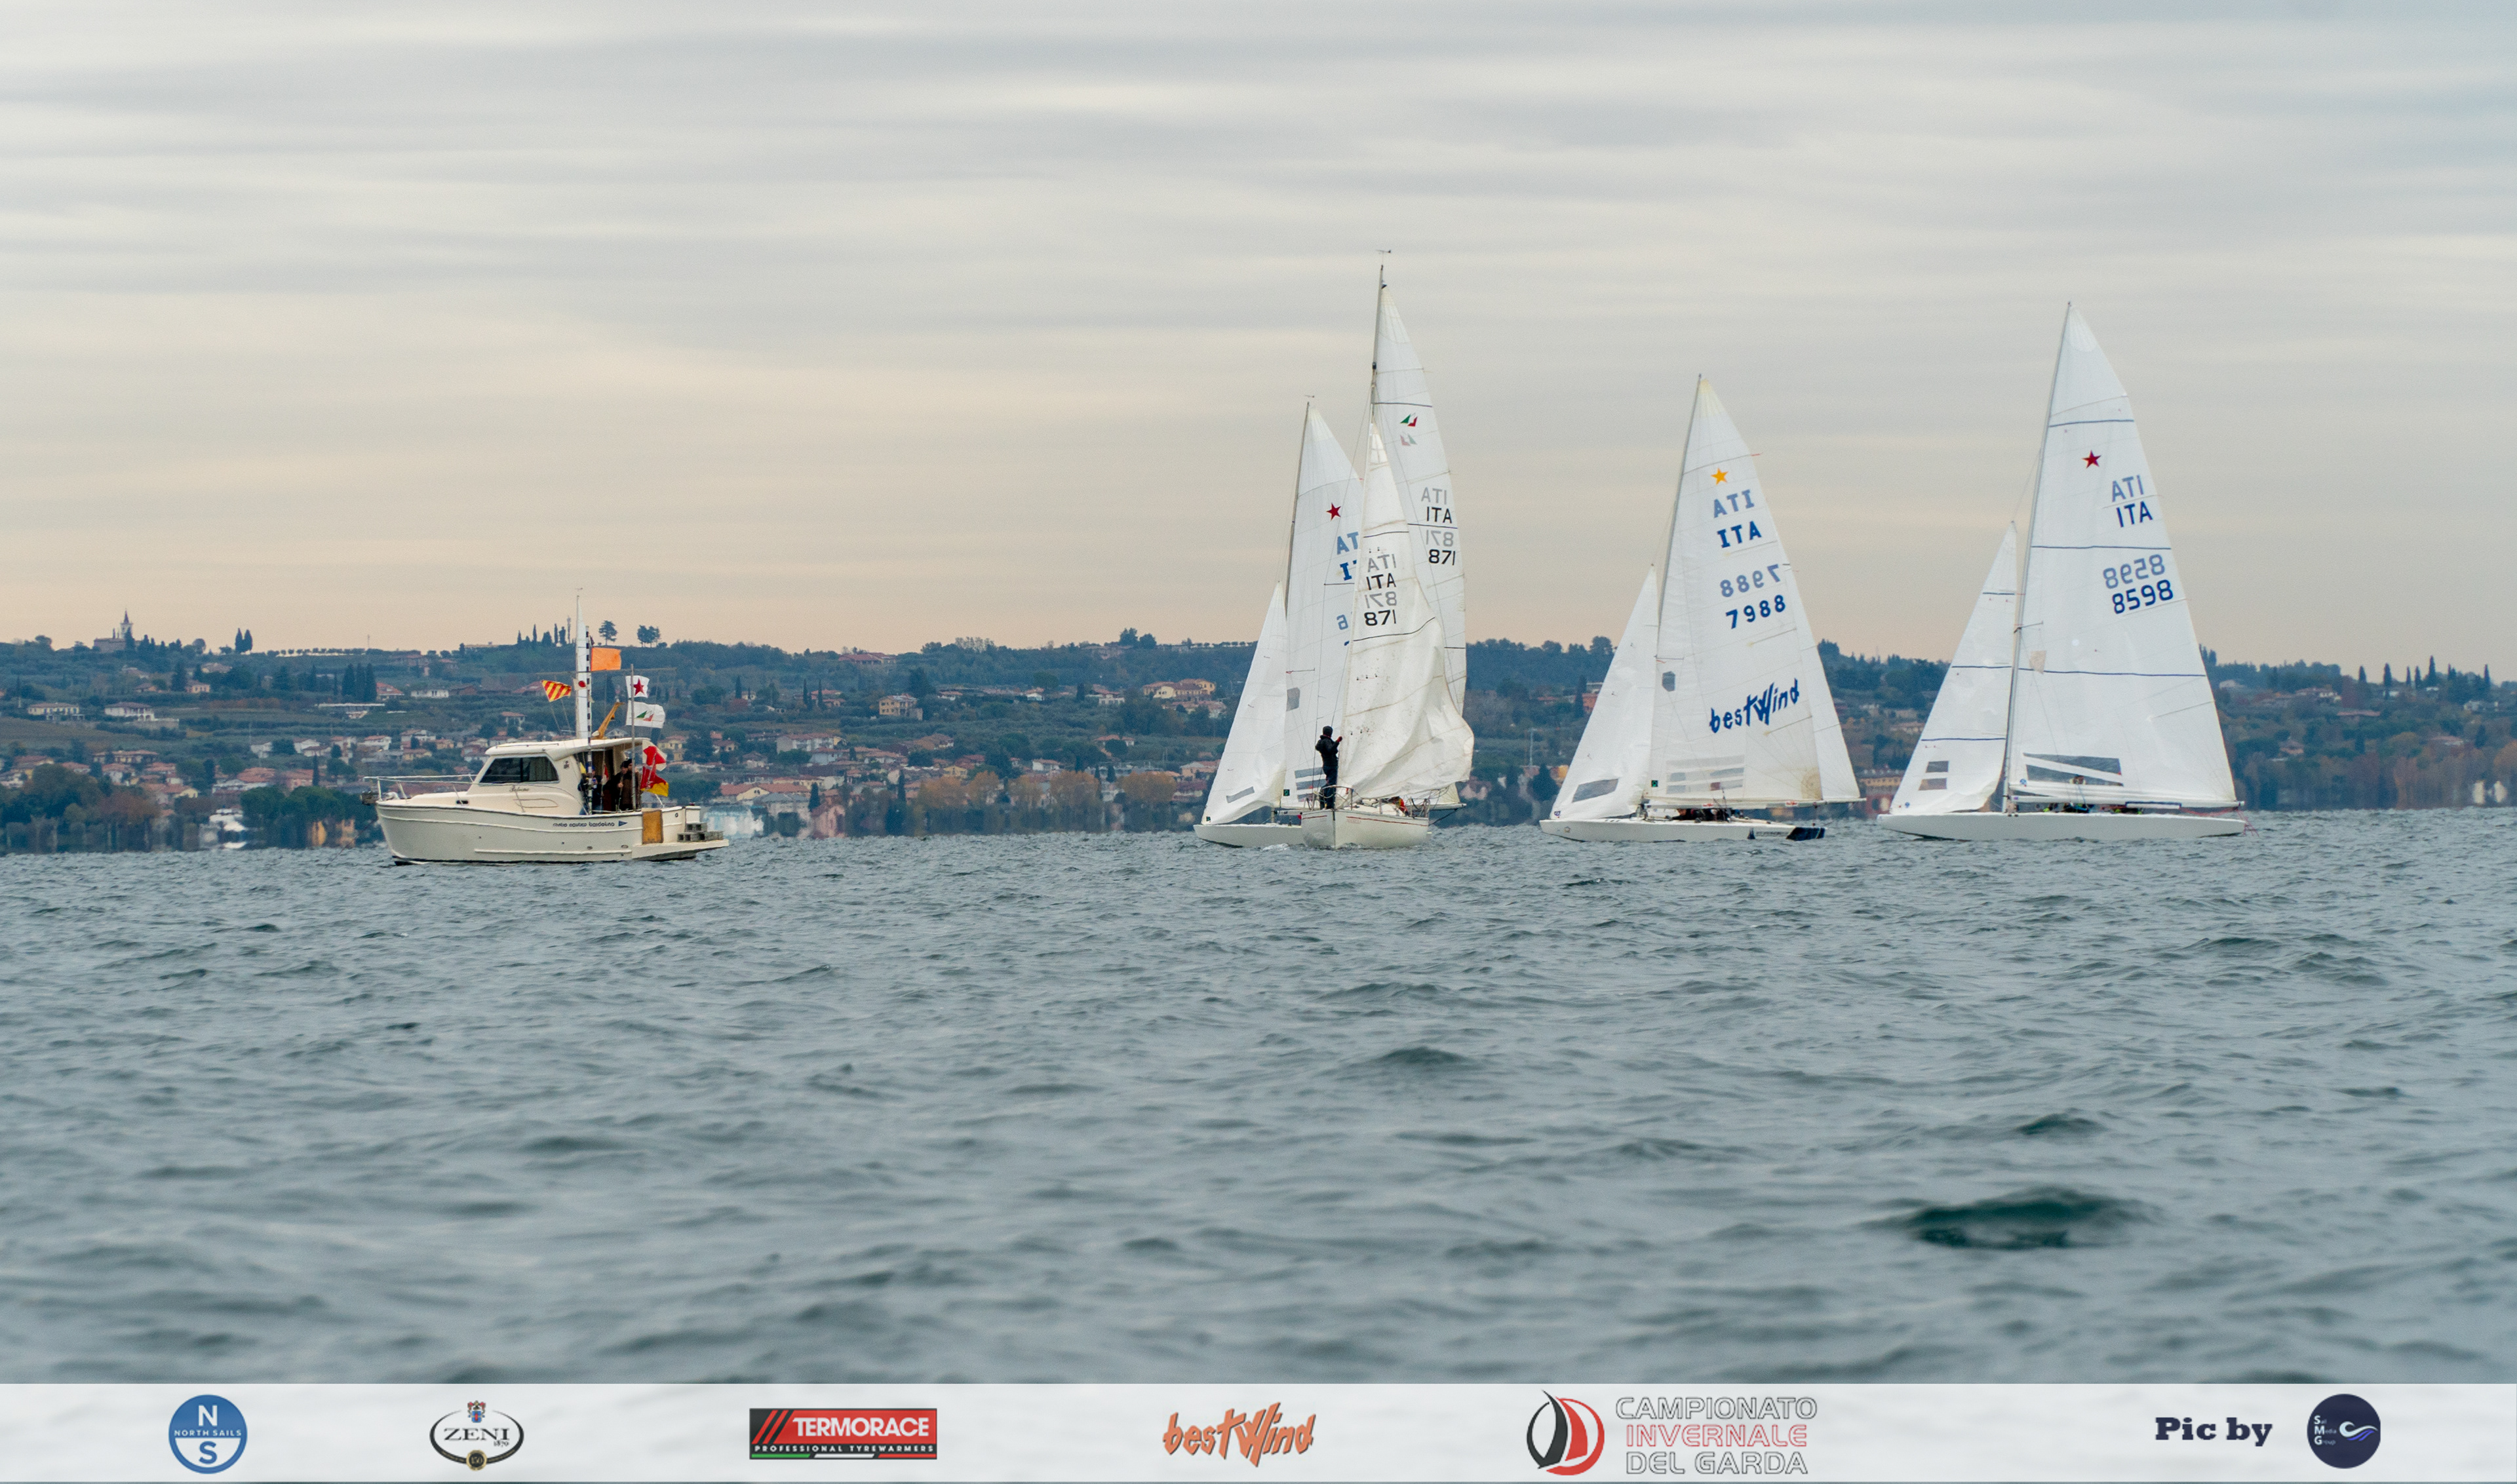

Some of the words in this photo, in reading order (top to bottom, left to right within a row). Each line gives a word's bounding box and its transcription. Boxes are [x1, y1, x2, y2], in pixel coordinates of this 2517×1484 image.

[1427, 506, 1453, 524] ITA
[2116, 501, 2153, 528] ITA
[1717, 520, 1762, 548] ITA
[1428, 549, 1456, 566] 871
[1366, 572, 1397, 591] ITA
[2112, 579, 2174, 614] 8598
[1364, 609, 1397, 627] 871
[1726, 595, 1786, 629] 7988
